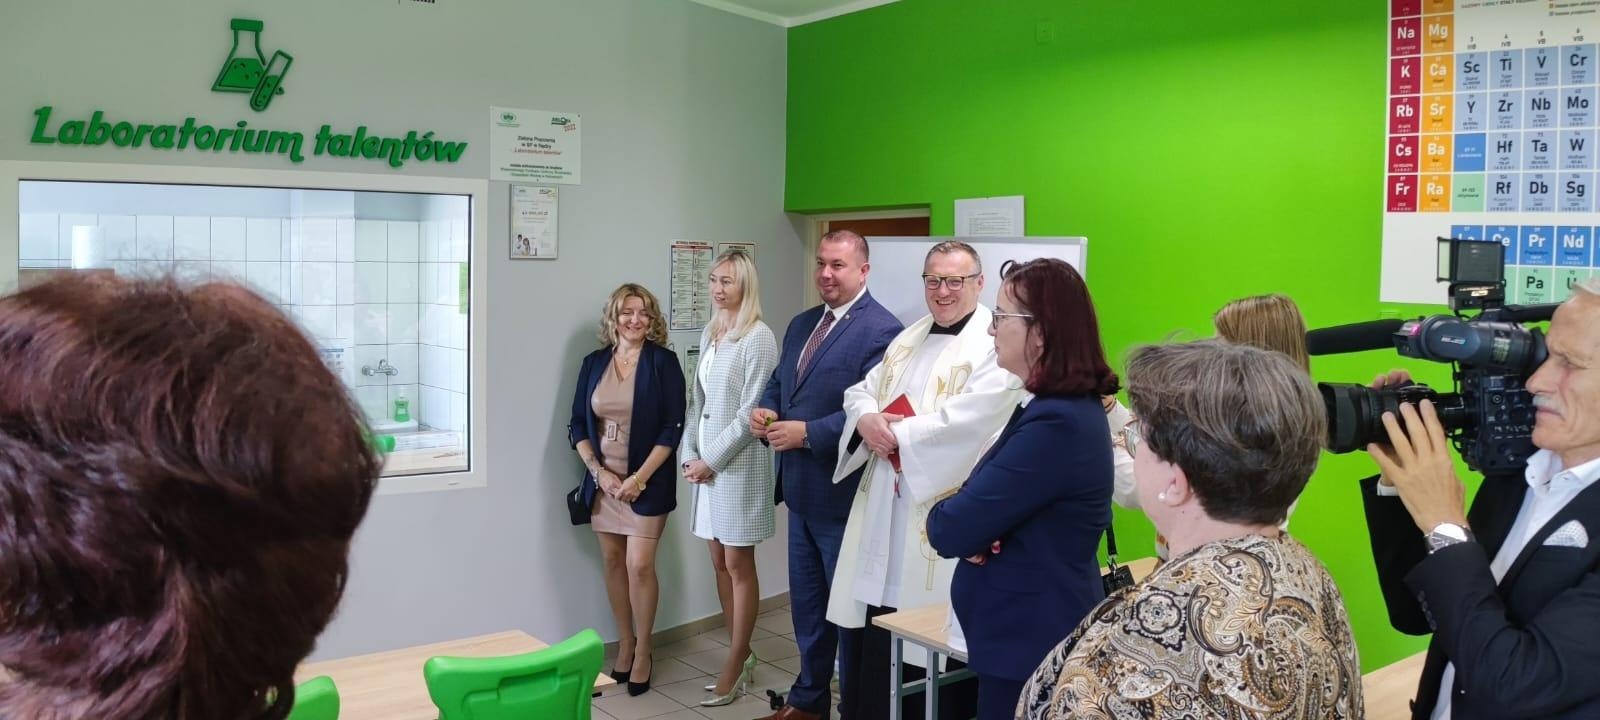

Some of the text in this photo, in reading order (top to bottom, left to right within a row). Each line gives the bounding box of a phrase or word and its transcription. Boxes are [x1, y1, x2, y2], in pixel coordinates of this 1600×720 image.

[1397, 27, 1415, 39] Na
[1428, 24, 1448, 38] Mg
[1463, 61, 1480, 73] Sc
[1500, 58, 1512, 71] Ti
[1537, 56, 1547, 68] V
[1570, 54, 1587, 67] Cr
[1401, 65, 1410, 78] K
[1429, 64, 1447, 76] Ca
[1467, 101, 1476, 113] Y
[1498, 100, 1514, 112] Zr
[1531, 98, 1551, 111] Nb
[1567, 96, 1589, 109] Mo
[1396, 104, 1413, 117] Rb
[1429, 103, 1446, 116] Sr
[31, 106, 468, 168] Laboratorium talentów
[1395, 144, 1412, 157] Cs
[1427, 143, 1445, 155] Ba
[1497, 141, 1513, 153] Hf
[1532, 140, 1548, 152] Ta
[1569, 139, 1585, 151] W
[1395, 183, 1410, 196] Fr
[1426, 182, 1444, 195] Ra
[1496, 182, 1511, 195] Rf
[1529, 182, 1548, 195] Db
[1566, 181, 1585, 197] Sg
[1528, 235, 1545, 247] Pr
[1563, 235, 1584, 248] Nd
[1526, 276, 1544, 289] Pa
